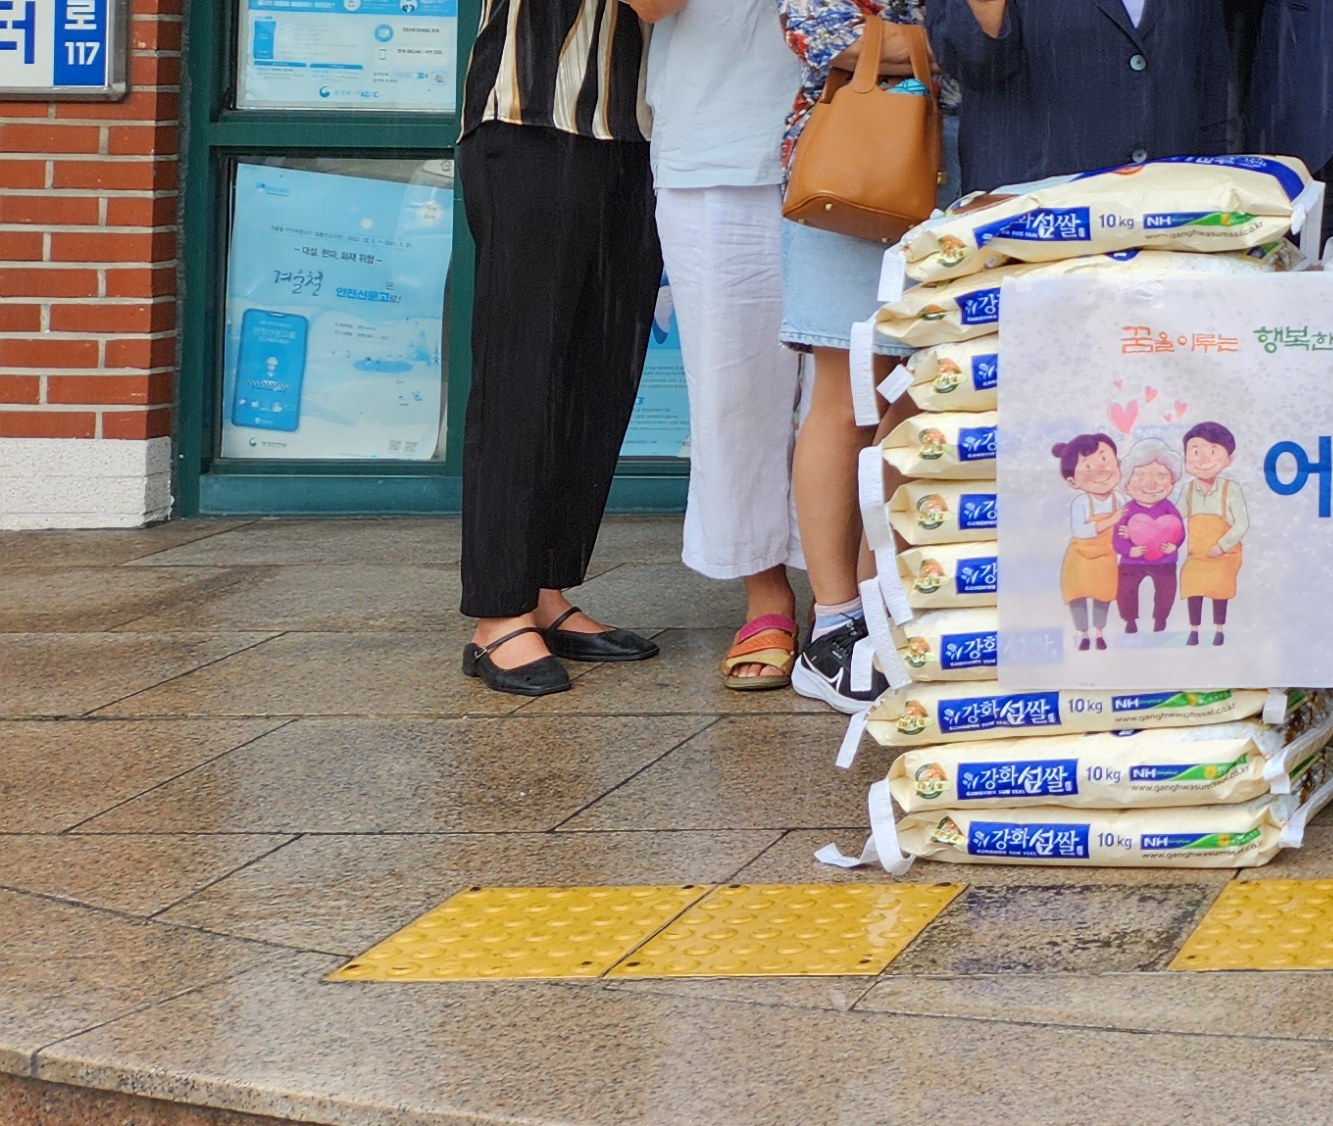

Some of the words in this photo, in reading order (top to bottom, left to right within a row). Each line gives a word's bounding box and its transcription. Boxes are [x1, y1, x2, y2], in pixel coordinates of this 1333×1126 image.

[64, 40, 101, 68] 117
[1146, 215, 1172, 226] NH
[272, 268, 325, 297] 겨울철
[961, 698, 1050, 725] 강화섬쌀
[1115, 697, 1140, 711] NH
[980, 764, 1068, 794] 강화섬쌀
[1132, 767, 1157, 779] NH
[990, 827, 1080, 856] 강화섬쌀
[1143, 836, 1168, 848] NH
